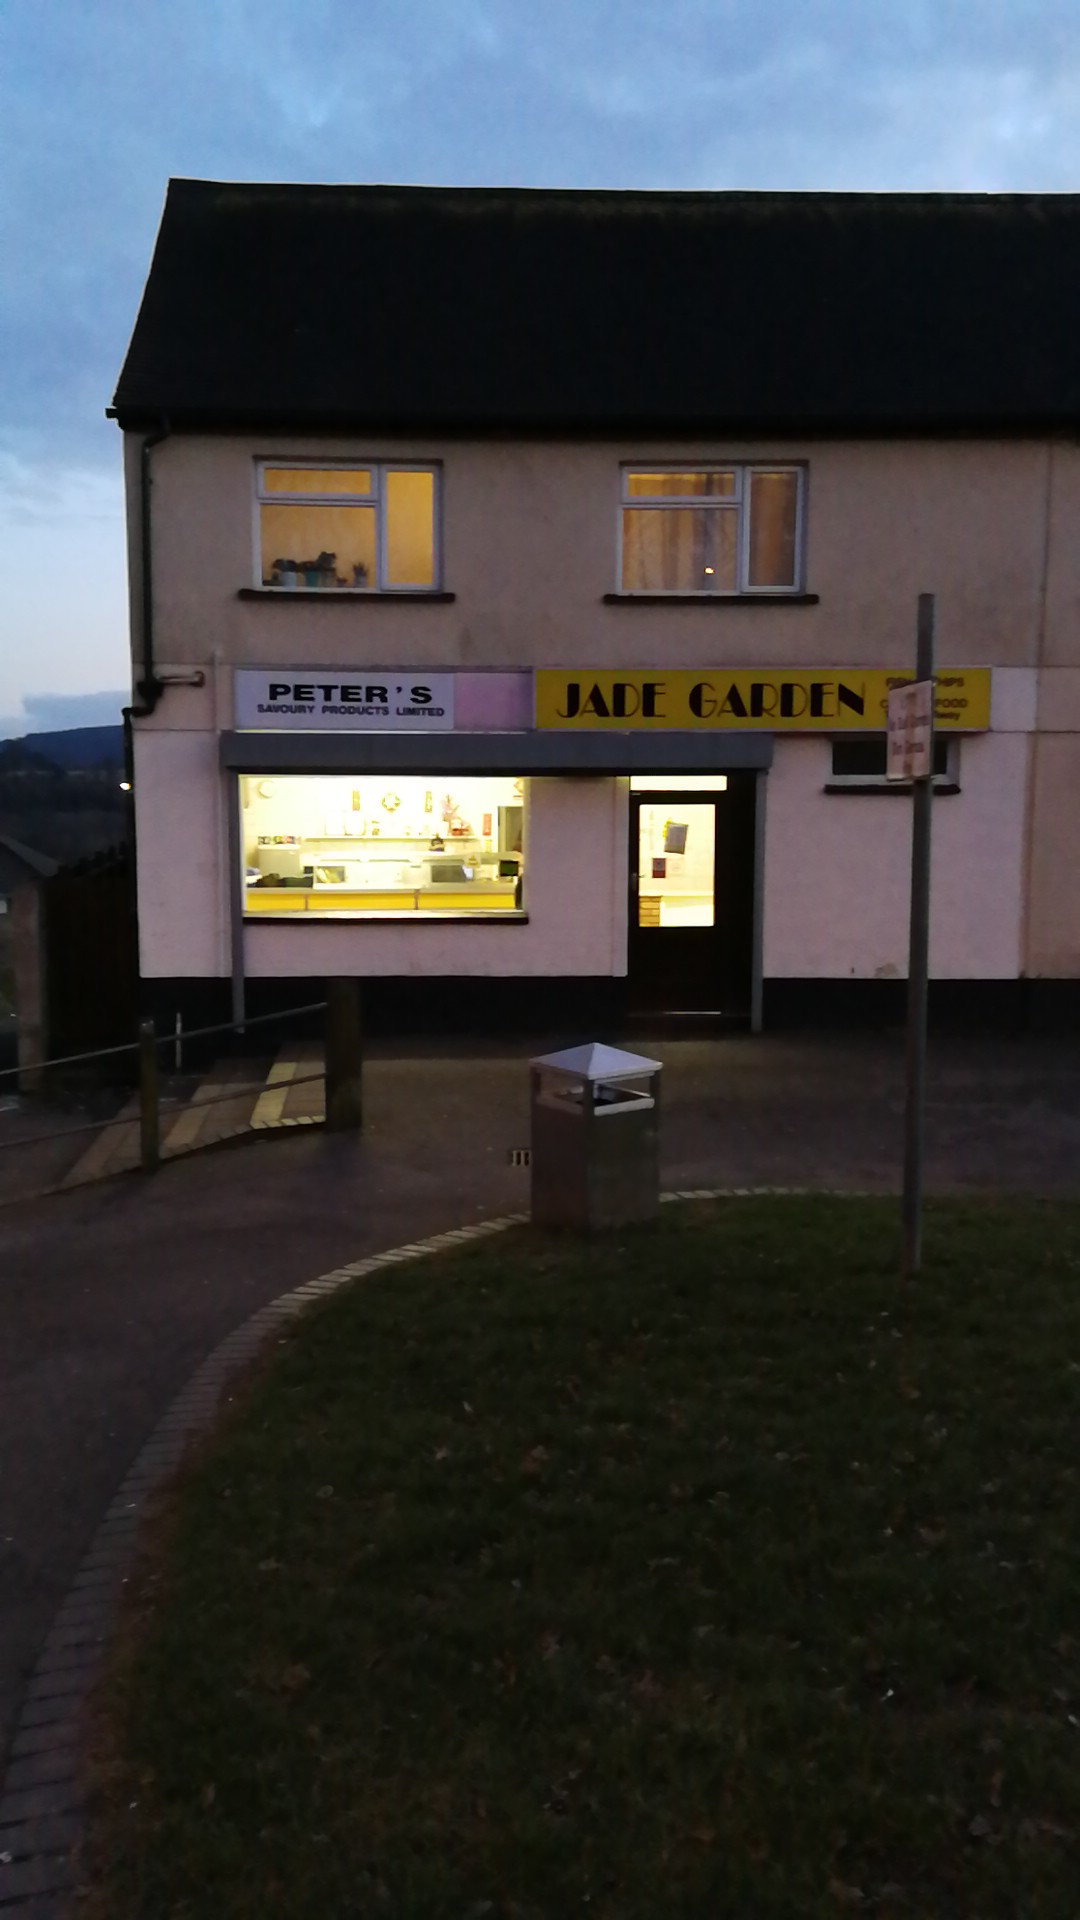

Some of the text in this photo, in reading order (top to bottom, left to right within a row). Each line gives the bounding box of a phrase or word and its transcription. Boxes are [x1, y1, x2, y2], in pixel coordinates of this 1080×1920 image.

[268, 683, 433, 704] PETER'S
[556, 682, 867, 719] JADE GARDEN
[257, 703, 445, 717] SAVOURY PRODUCTS LIMITED
